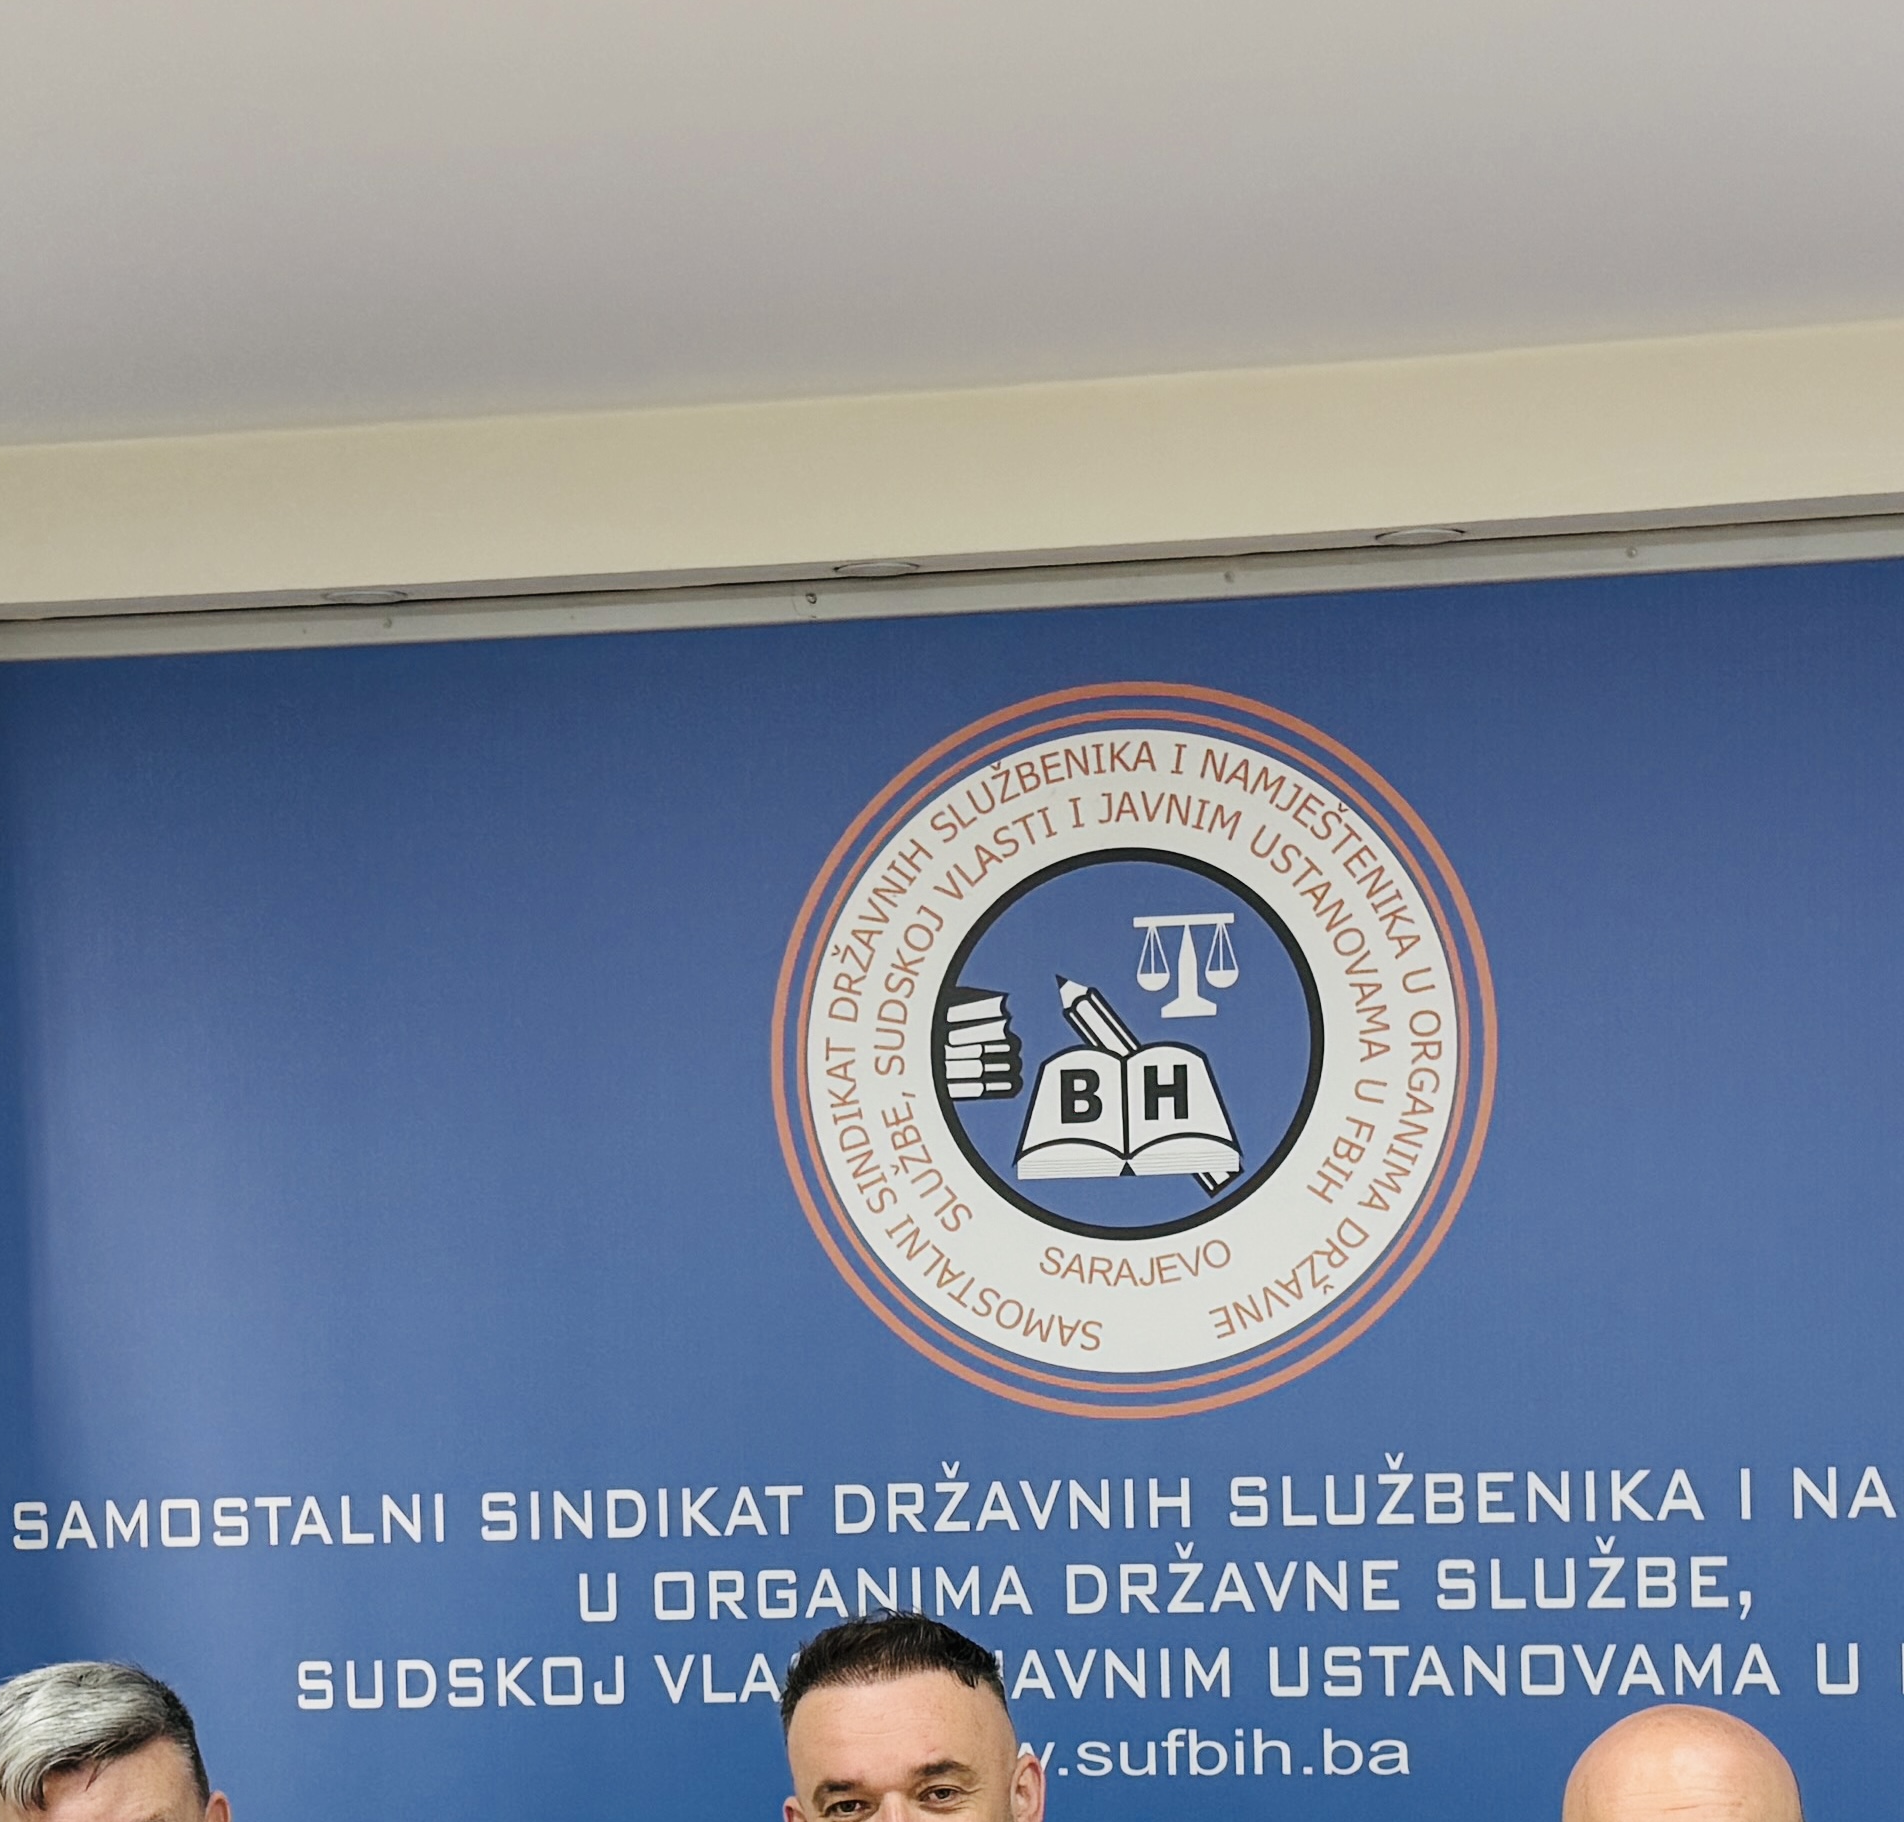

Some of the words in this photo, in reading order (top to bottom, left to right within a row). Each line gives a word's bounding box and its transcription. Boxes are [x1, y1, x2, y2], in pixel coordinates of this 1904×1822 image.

[930, 740, 1157, 844] SLUŽBENIKA
[1170, 743, 1188, 775] I
[932, 806, 1058, 901] VLASTI
[1068, 796, 1085, 829] I
[1097, 790, 1243, 841] JAVNIM
[1199, 747, 1424, 961] NAMJEŠTENIKA
[828, 837, 934, 1023] DRŽAVNIH
[1249, 824, 1391, 1063] USTANOVAMA
[873, 904, 944, 1076] SUDSKOJ
[1401, 966, 1436, 994] U
[824, 1036, 898, 1214] SINDIKAT
[1060, 1070, 1105, 1125] B
[1143, 1064, 1189, 1121] H
[1354, 1078, 1388, 1105] U
[1357, 1009, 1443, 1212] ORGANIMA
[880, 1091, 973, 1233] SLUŽBE,
[1306, 1116, 1376, 1204] FBIH
[885, 1214, 1103, 1352] SAMOSTALNI
[1039, 1239, 1231, 1287] SARAJEVO
[1208, 1216, 1370, 1340] DRŽAVNE
[14, 1493, 444, 1549] SAMOSTALNI
[481, 1486, 803, 1541] SINDIKAT
[835, 1461, 1190, 1533] DRŽAVNIH
[1230, 1452, 1704, 1526] SLUŽBENIKA
[1741, 1468, 1751, 1519] I
[579, 1573, 617, 1622] U
[654, 1566, 1032, 1620] ORGANIMA
[1067, 1542, 1399, 1614] DRŽAVNE
[1437, 1536, 1751, 1620] SLUŽBE,
[298, 1656, 624, 1709] SUDSKOJ
[654, 1654, 800, 1703] VLA
[1270, 1644, 1780, 1698] USTANOVAMA
[1817, 1643, 1858, 1694] U
[1017, 1728, 1409, 1777] .sufbih.ba
